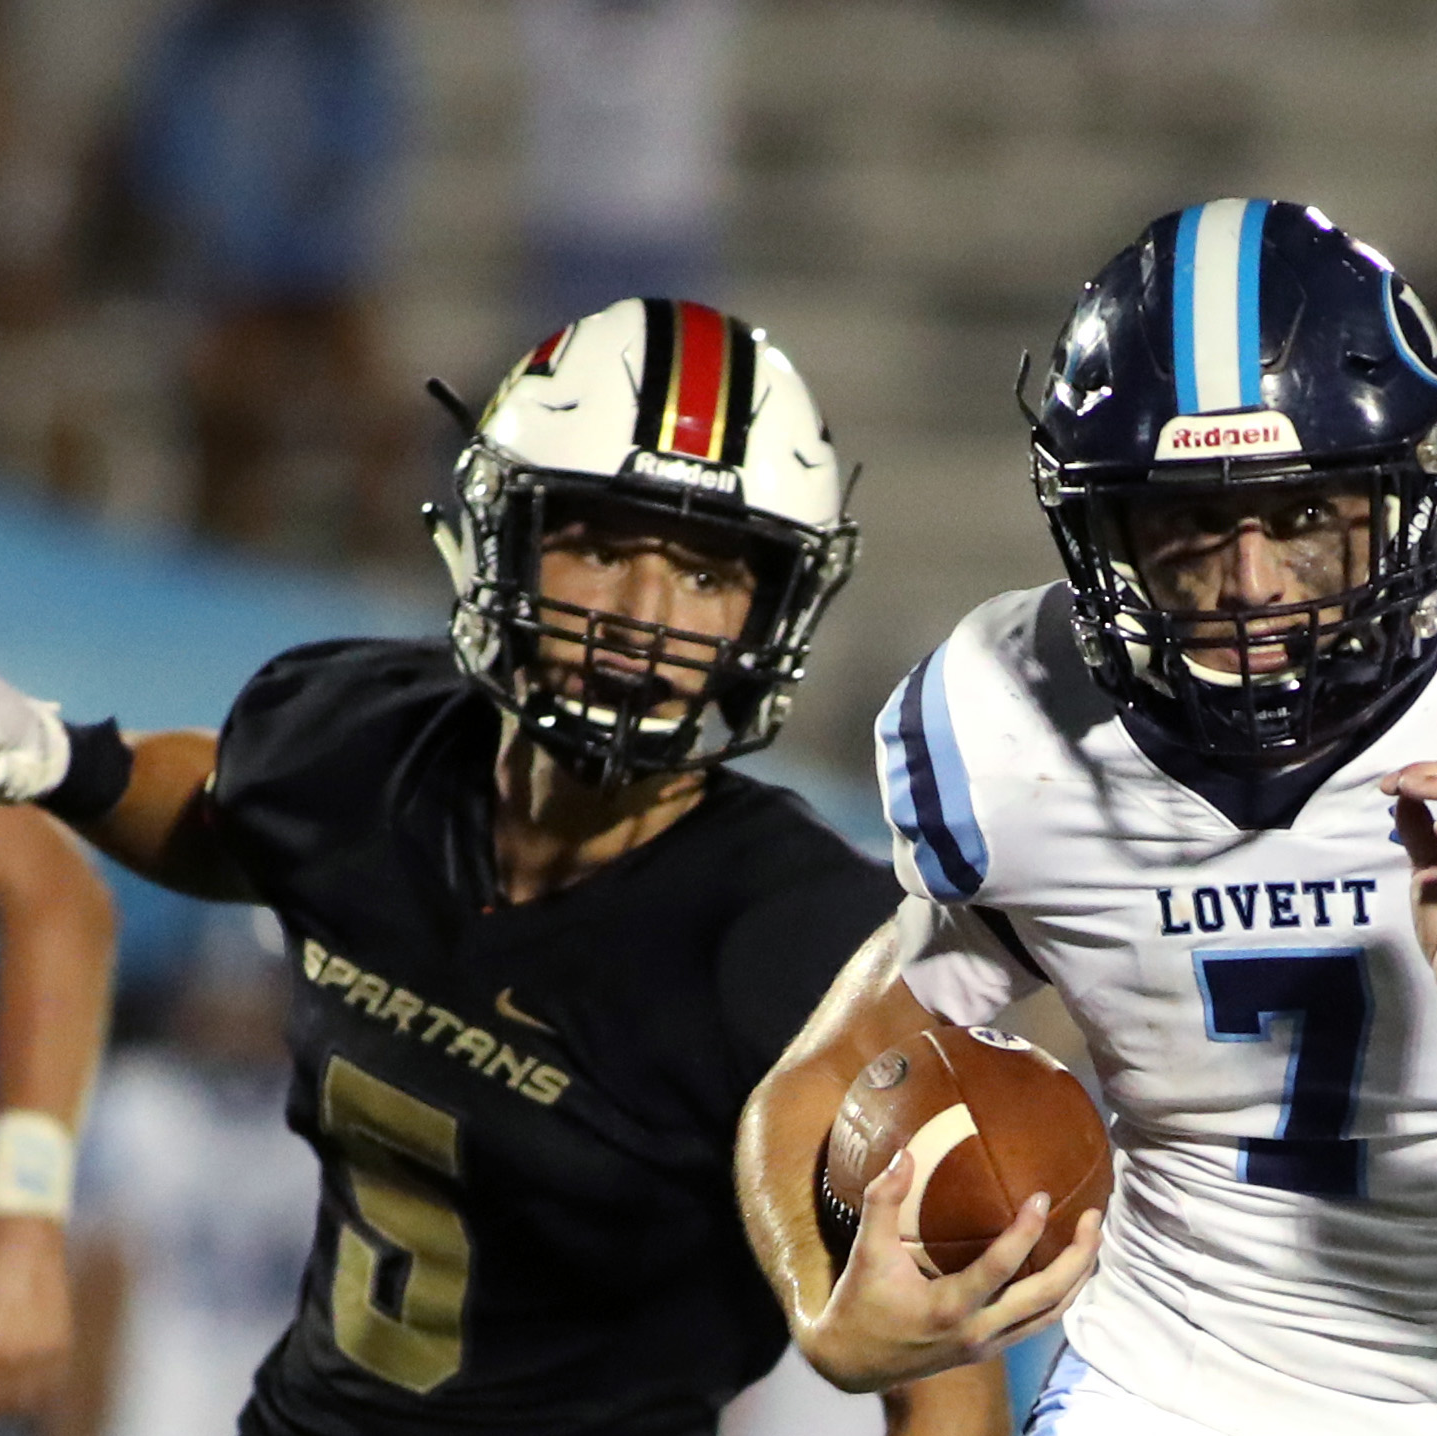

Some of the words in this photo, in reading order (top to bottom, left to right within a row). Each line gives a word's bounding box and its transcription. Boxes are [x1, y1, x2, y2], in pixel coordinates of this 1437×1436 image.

[634, 452, 736, 494] Riddell
[1156, 879, 1376, 936] LOVETT
[303, 938, 571, 1105] SPARTANS
[1191, 946, 1376, 1201] 7
[319, 1054, 471, 1395] 5
